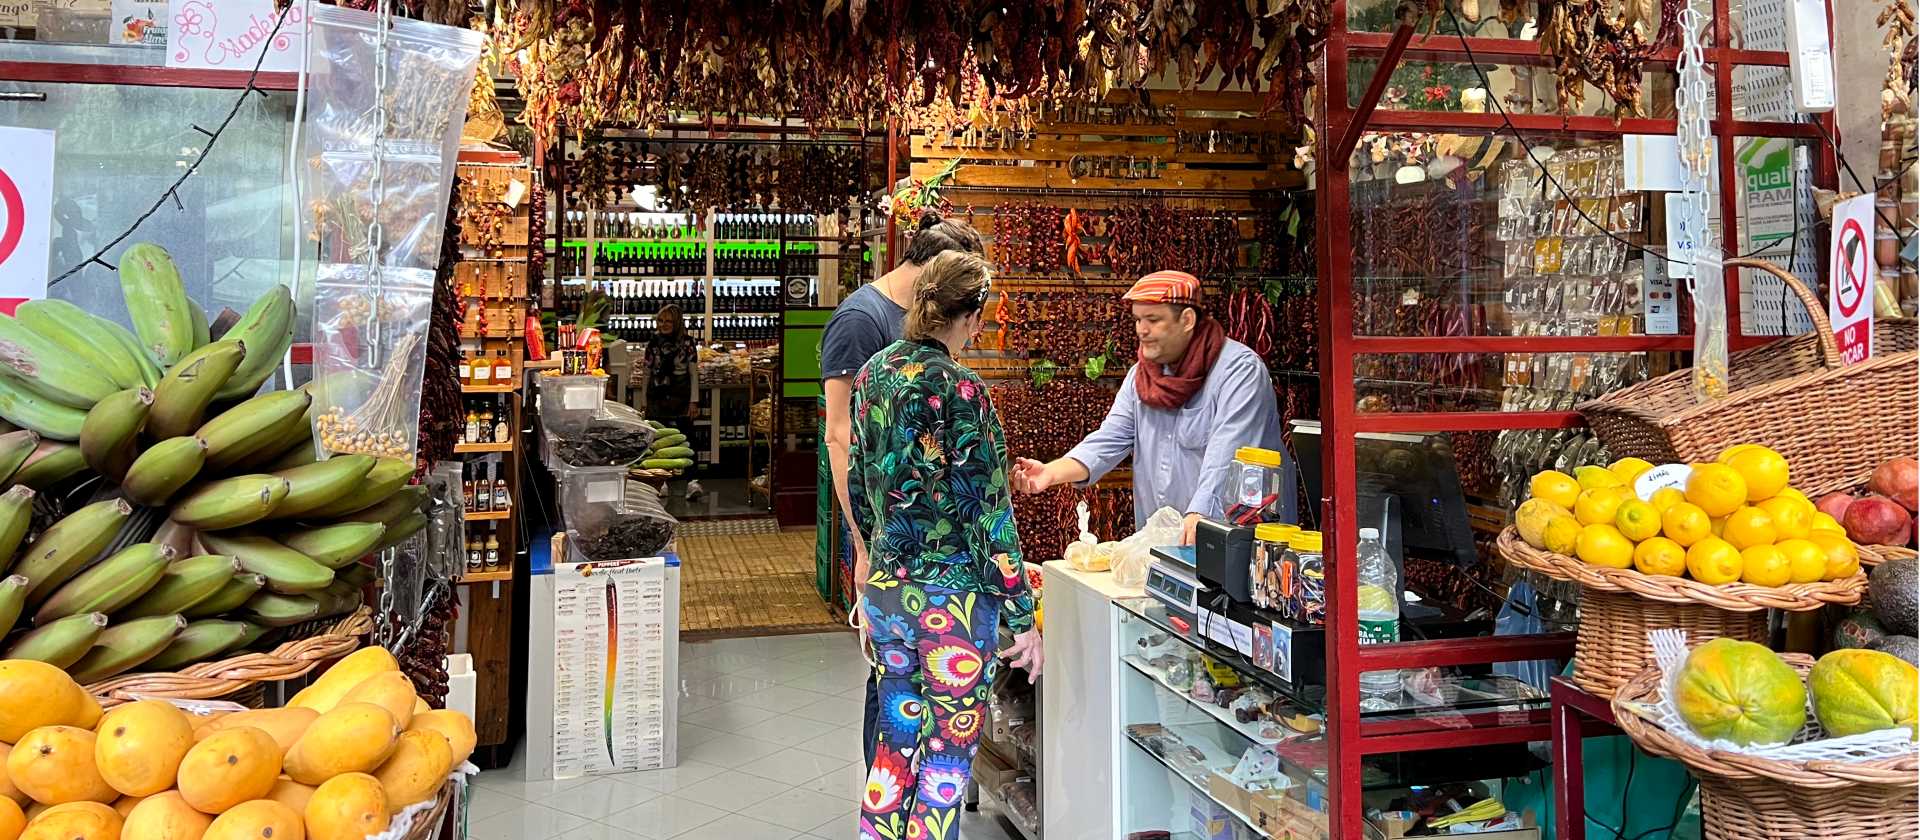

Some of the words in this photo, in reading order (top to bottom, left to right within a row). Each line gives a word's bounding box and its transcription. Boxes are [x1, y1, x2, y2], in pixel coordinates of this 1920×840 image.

[0, 4, 29, 16] ngo
[1748, 188, 1792, 204] RAM
[1844, 326, 1856, 348] NO
